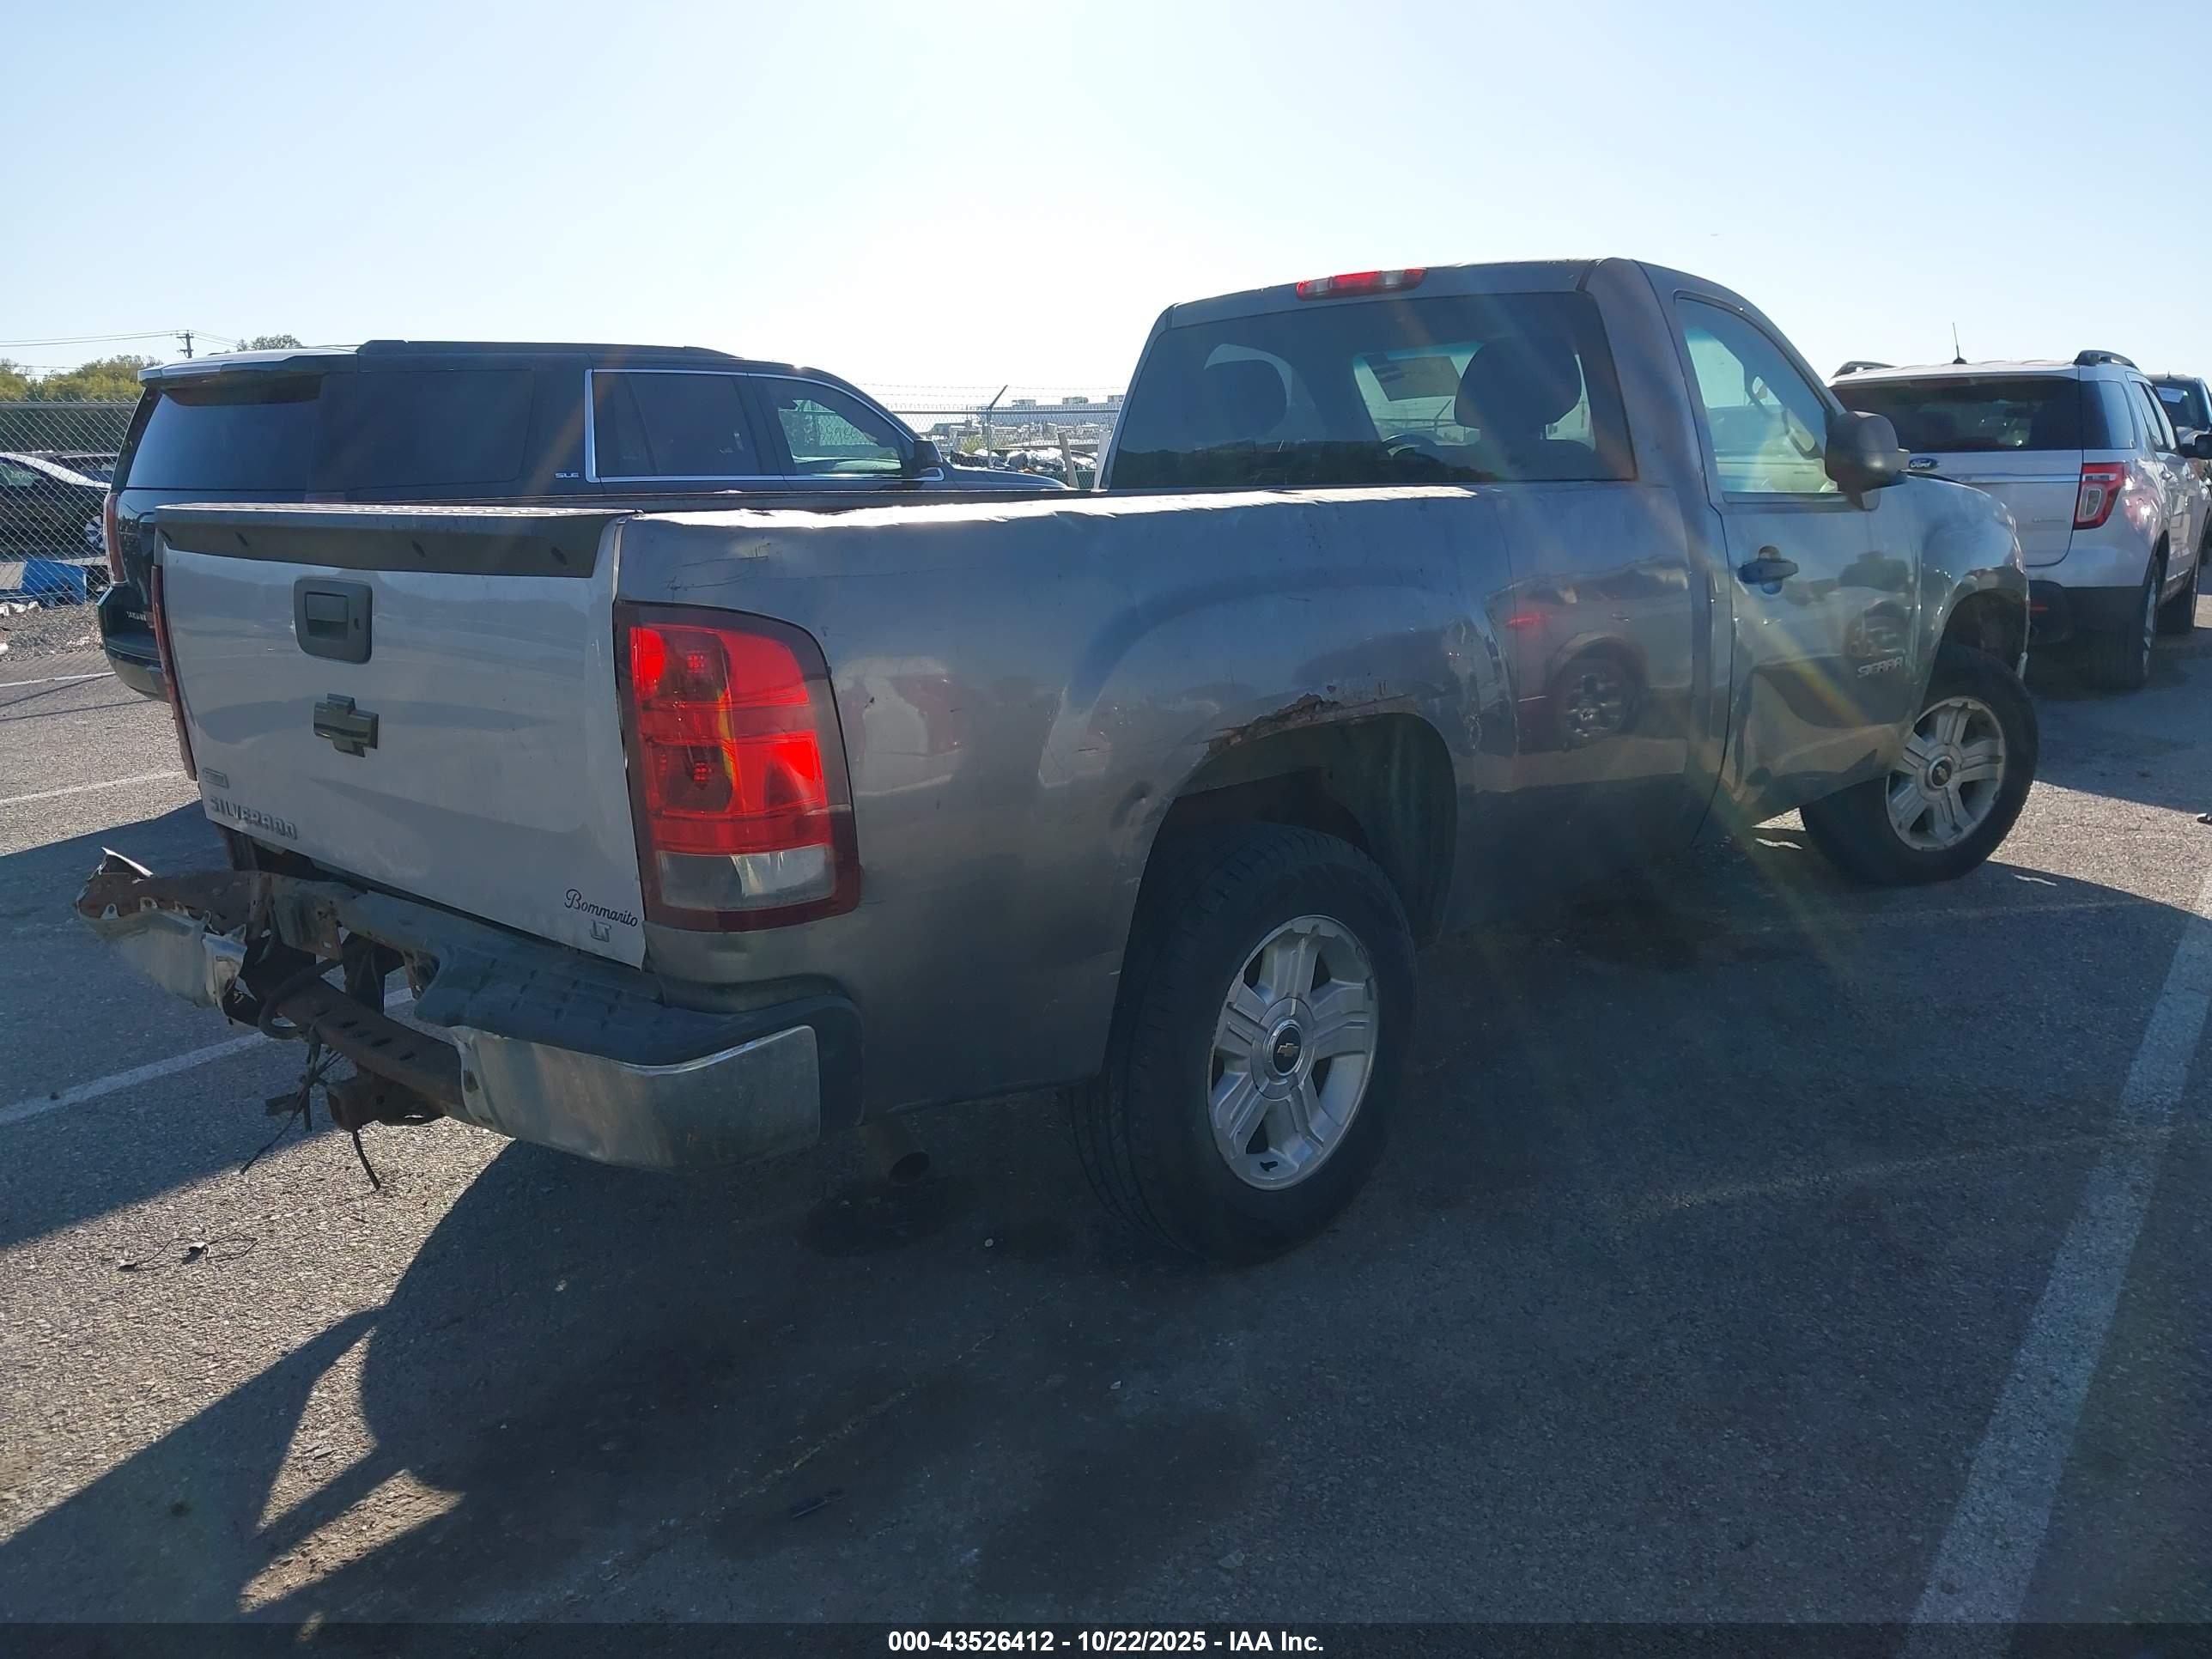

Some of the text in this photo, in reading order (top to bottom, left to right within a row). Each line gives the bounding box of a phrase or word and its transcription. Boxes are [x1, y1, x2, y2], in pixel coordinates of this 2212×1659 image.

[1856, 656, 1905, 678] SIERRA
[210, 795, 298, 841] SILVERADO
[564, 888, 638, 927] Bommarito
[589, 919, 612, 943] LT
